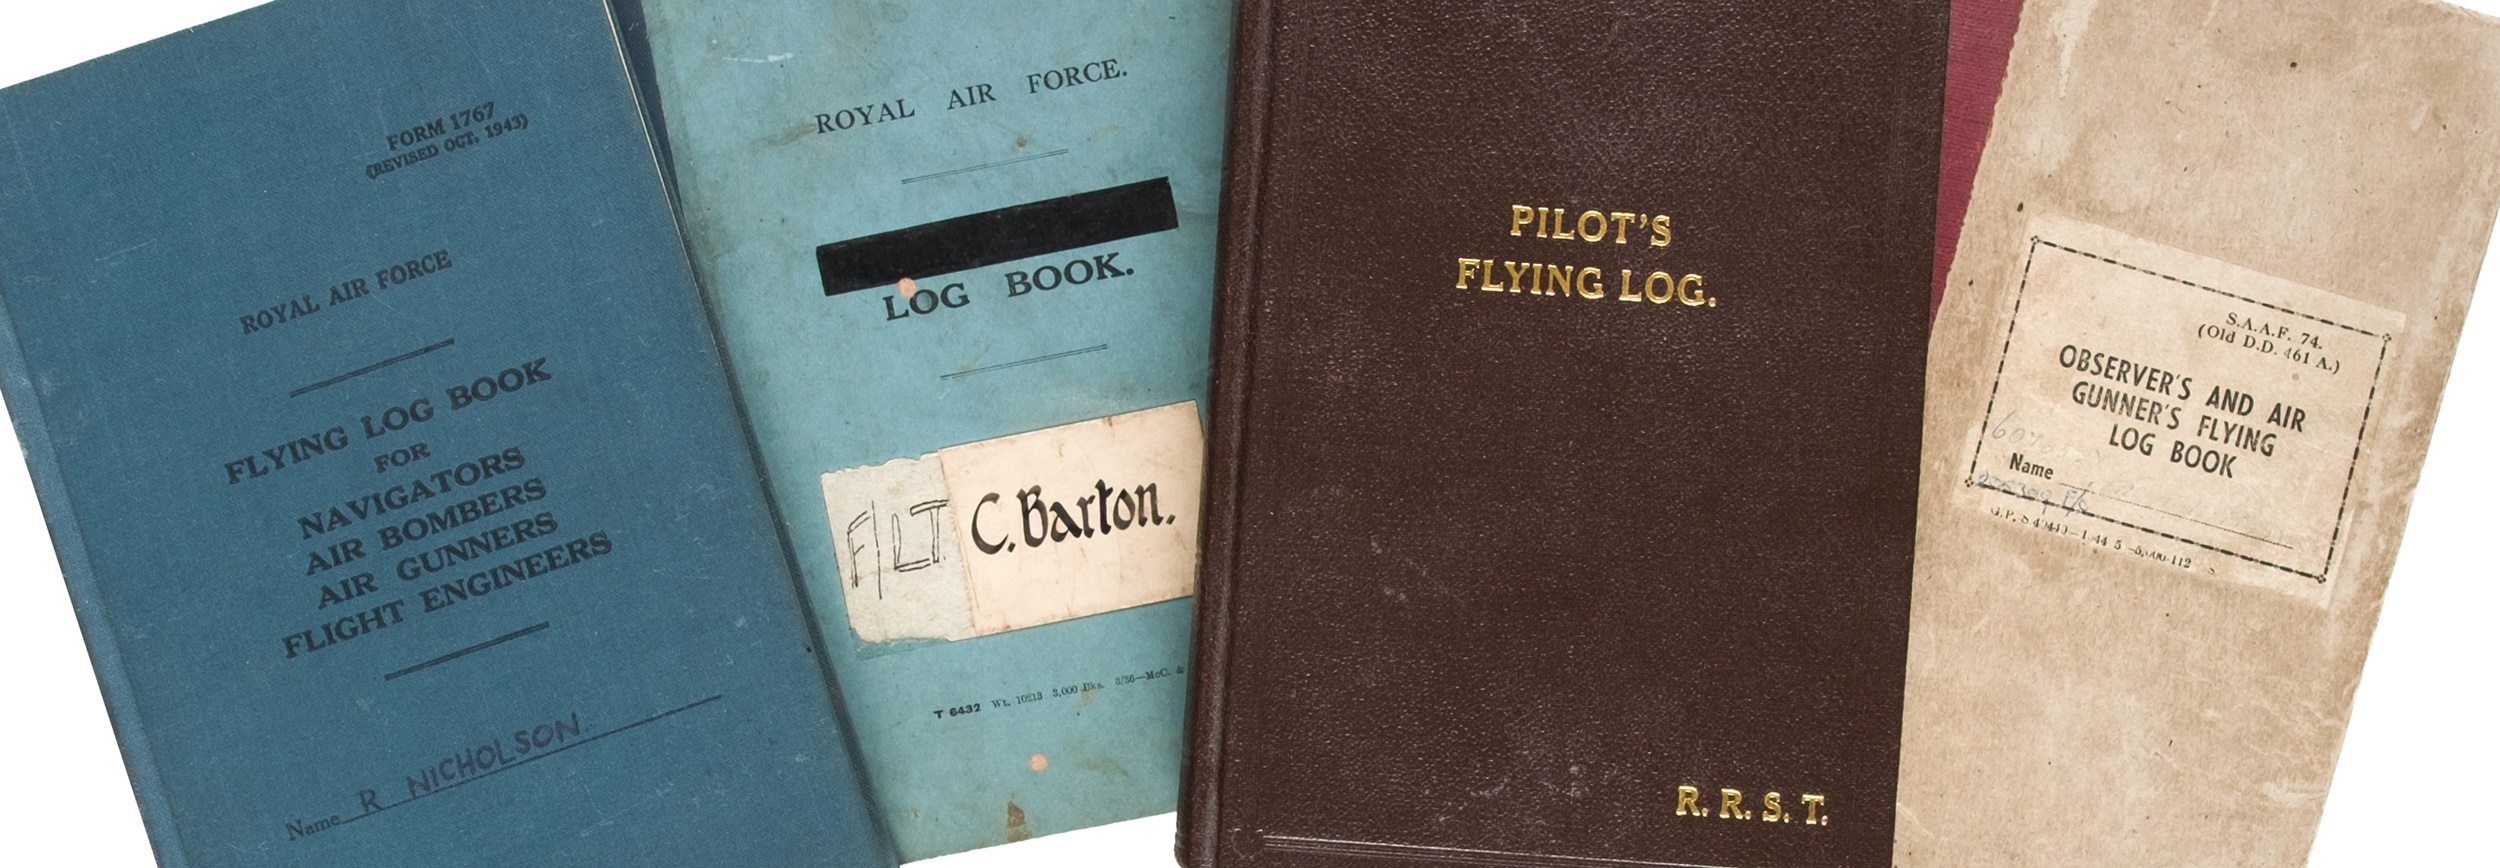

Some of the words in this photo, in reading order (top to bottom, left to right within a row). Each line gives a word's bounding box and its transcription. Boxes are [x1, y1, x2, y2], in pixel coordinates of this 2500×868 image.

[814, 97, 916, 135] ROYAL
[946, 82, 997, 111] AIR
[1026, 58, 1128, 95] FORCE.
[365, 144, 440, 180] (REVISED
[444, 131, 480, 153] OCT.
[484, 113, 529, 139] 1943)
[386, 117, 446, 151] FORM
[450, 101, 495, 131] 1767
[1510, 204, 1672, 247] PILOT'S
[240, 294, 321, 335] ROYAL
[328, 278, 370, 306] AIR
[375, 249, 453, 289] FORCE
[883, 283, 970, 321] LOG
[1005, 252, 1134, 297] BOOK.
[1456, 257, 1604, 300] FLYING
[1618, 269, 1716, 307] LOG.
[2198, 323, 2236, 344] (Old
[2243, 334, 2277, 355] D.D.
[2283, 347, 2310, 365] 461
[2316, 356, 2340, 375] A.)
[2226, 312, 2291, 341] S.A.A.F.
[2301, 332, 2322, 349] 74.
[2059, 344, 2192, 401] OBSERVER'S
[2206, 385, 2254, 417] AND
[2267, 402, 2306, 433] AIR
[224, 426, 349, 485] FLYING
[360, 398, 434, 440] LOG
[445, 357, 552, 411] BOOK
[2072, 381, 2182, 430] GUNNER'S
[2197, 414, 2277, 457] FLYING
[373, 442, 430, 473] FOR
[2009, 452, 2054, 480] Name
[2109, 423, 2156, 457] LOG
[2170, 440, 2237, 478] BOOK
[297, 446, 526, 540] NAVIGATORS
[306, 538, 366, 576] AIR
[377, 477, 547, 550] BOMBERS
[318, 572, 379, 609] AIR
[396, 511, 558, 582] GUNNERS
[282, 599, 405, 659] FLIGHT
[418, 529, 613, 613] ENGINEERS
[933, 709, 944, 719] T
[949, 703, 981, 717] 6432
[1052, 684, 1078, 698] 3,000
[284, 811, 340, 841] Name
[358, 788, 383, 813] R
[1675, 785, 1708, 817] R.
[1719, 788, 1751, 820] R.
[1762, 791, 1790, 823] S.
[1801, 793, 1829, 826] T.
